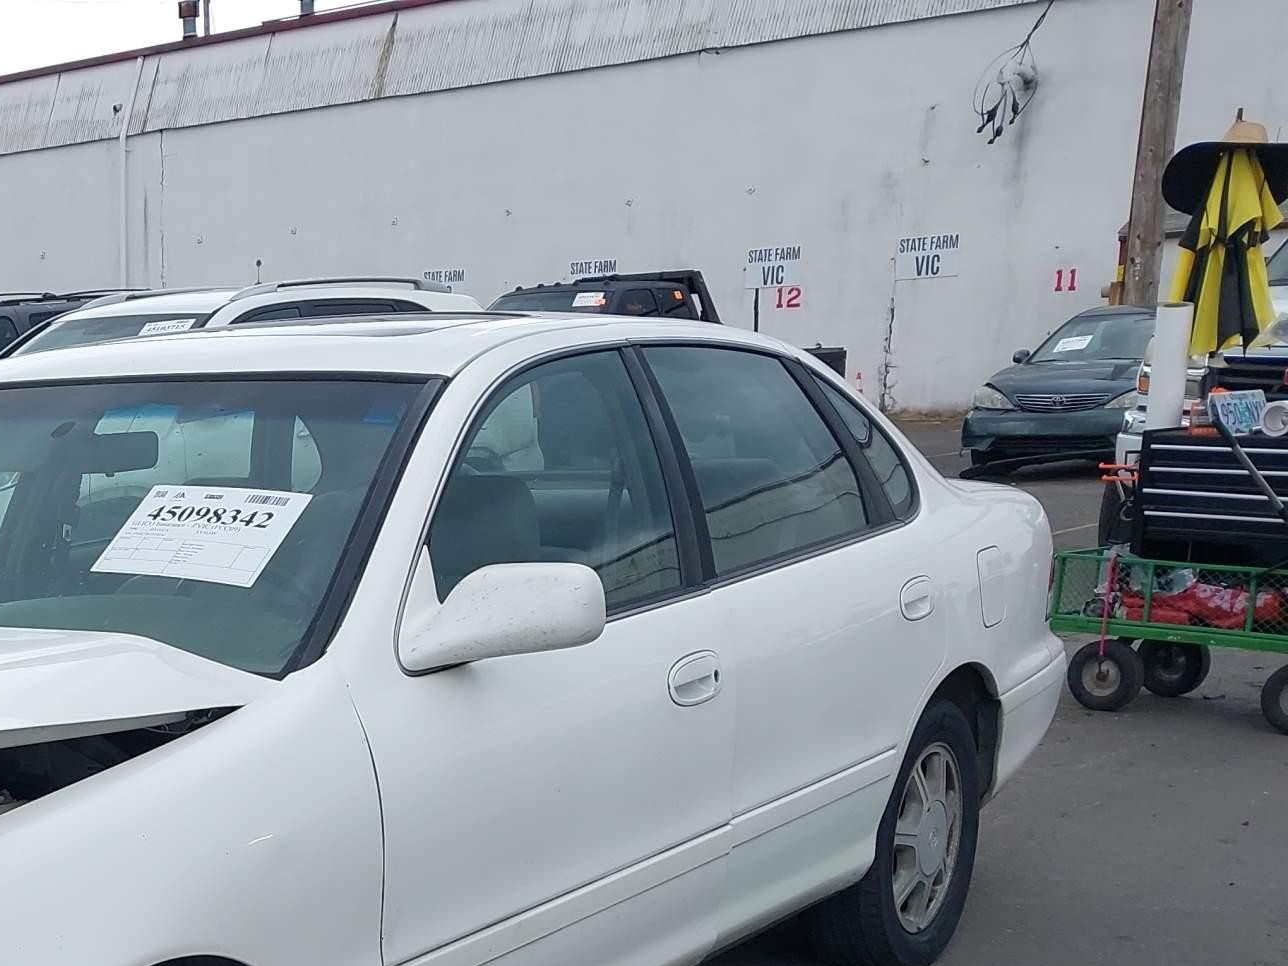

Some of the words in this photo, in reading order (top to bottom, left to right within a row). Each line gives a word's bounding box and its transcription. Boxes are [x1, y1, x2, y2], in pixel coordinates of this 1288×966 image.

[899, 236, 928, 253] STATE
[929, 234, 960, 251] FARM
[748, 248, 773, 264] STATE
[774, 246, 801, 262] FARM
[915, 254, 940, 277] VIC
[570, 261, 593, 275] STATE
[593, 259, 617, 274] FARM
[762, 264, 785, 286] VIC
[1055, 268, 1077, 291] 11
[776, 287, 801, 309] 12
[147, 504, 274, 529] 45098342
